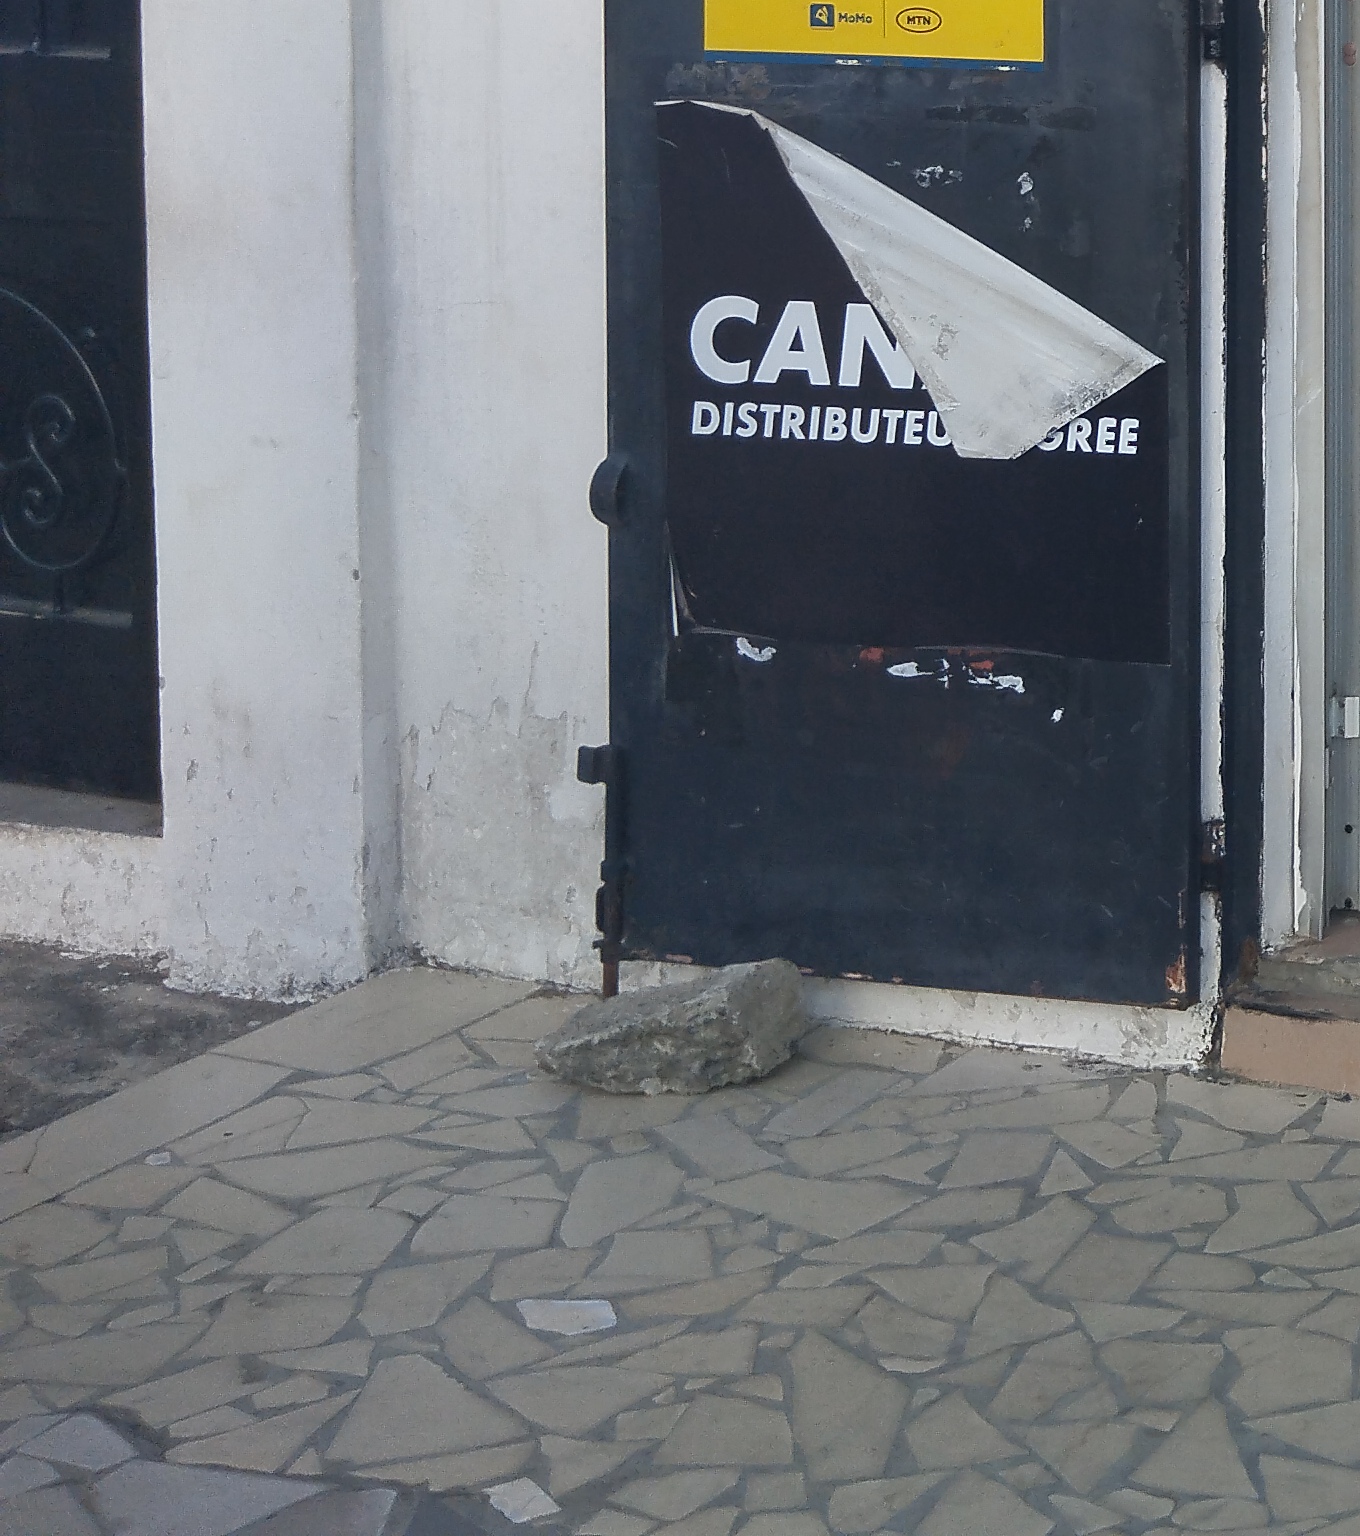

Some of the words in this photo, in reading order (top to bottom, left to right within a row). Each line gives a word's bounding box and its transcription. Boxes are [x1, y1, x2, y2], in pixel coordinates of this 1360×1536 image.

[838, 12, 873, 24] MoMo
[906, 15, 931, 26] MTN
[690, 295, 922, 388] CAN
[690, 400, 953, 448] DISTRIBUTEU
